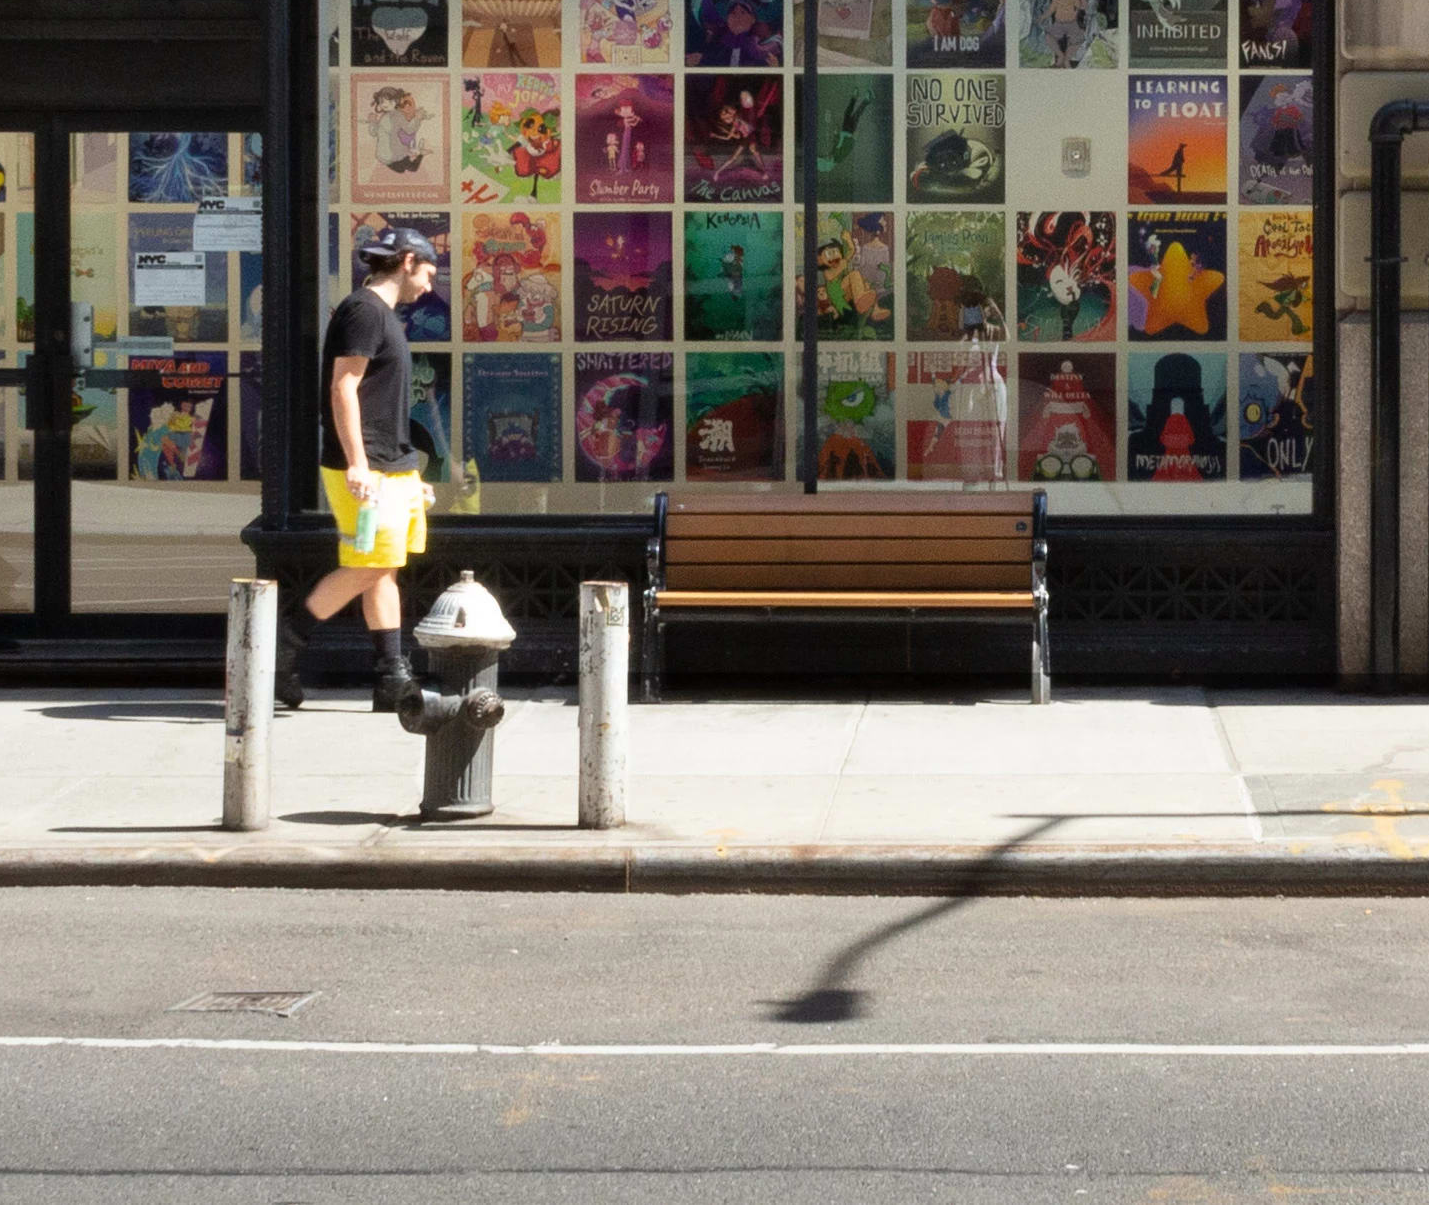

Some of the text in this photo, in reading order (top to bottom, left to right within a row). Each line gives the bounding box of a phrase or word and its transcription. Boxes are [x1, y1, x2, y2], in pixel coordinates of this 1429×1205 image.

[1136, 23, 1222, 40] INHIBITED
[941, 36, 956, 51] AM
[960, 36, 980, 51] DOG
[912, 77, 999, 102] NO ONE
[1135, 80, 1221, 94] LEARNING
[907, 103, 1006, 127] SURVIVED
[1134, 98, 1224, 118] TO FLOAT
[589, 179, 660, 199] Slumber Party
[691, 179, 781, 201] The Canvas
[199, 200, 225, 209] NYC
[139, 254, 166, 264] NYC
[587, 294, 661, 315] SATURN
[586, 316, 659, 339] RISING
[177, 362, 210, 374] AND
[576, 353, 672, 371] SHATTERED
[162, 376, 223, 389] COMET
[1267, 436, 1313, 472] ONLY
